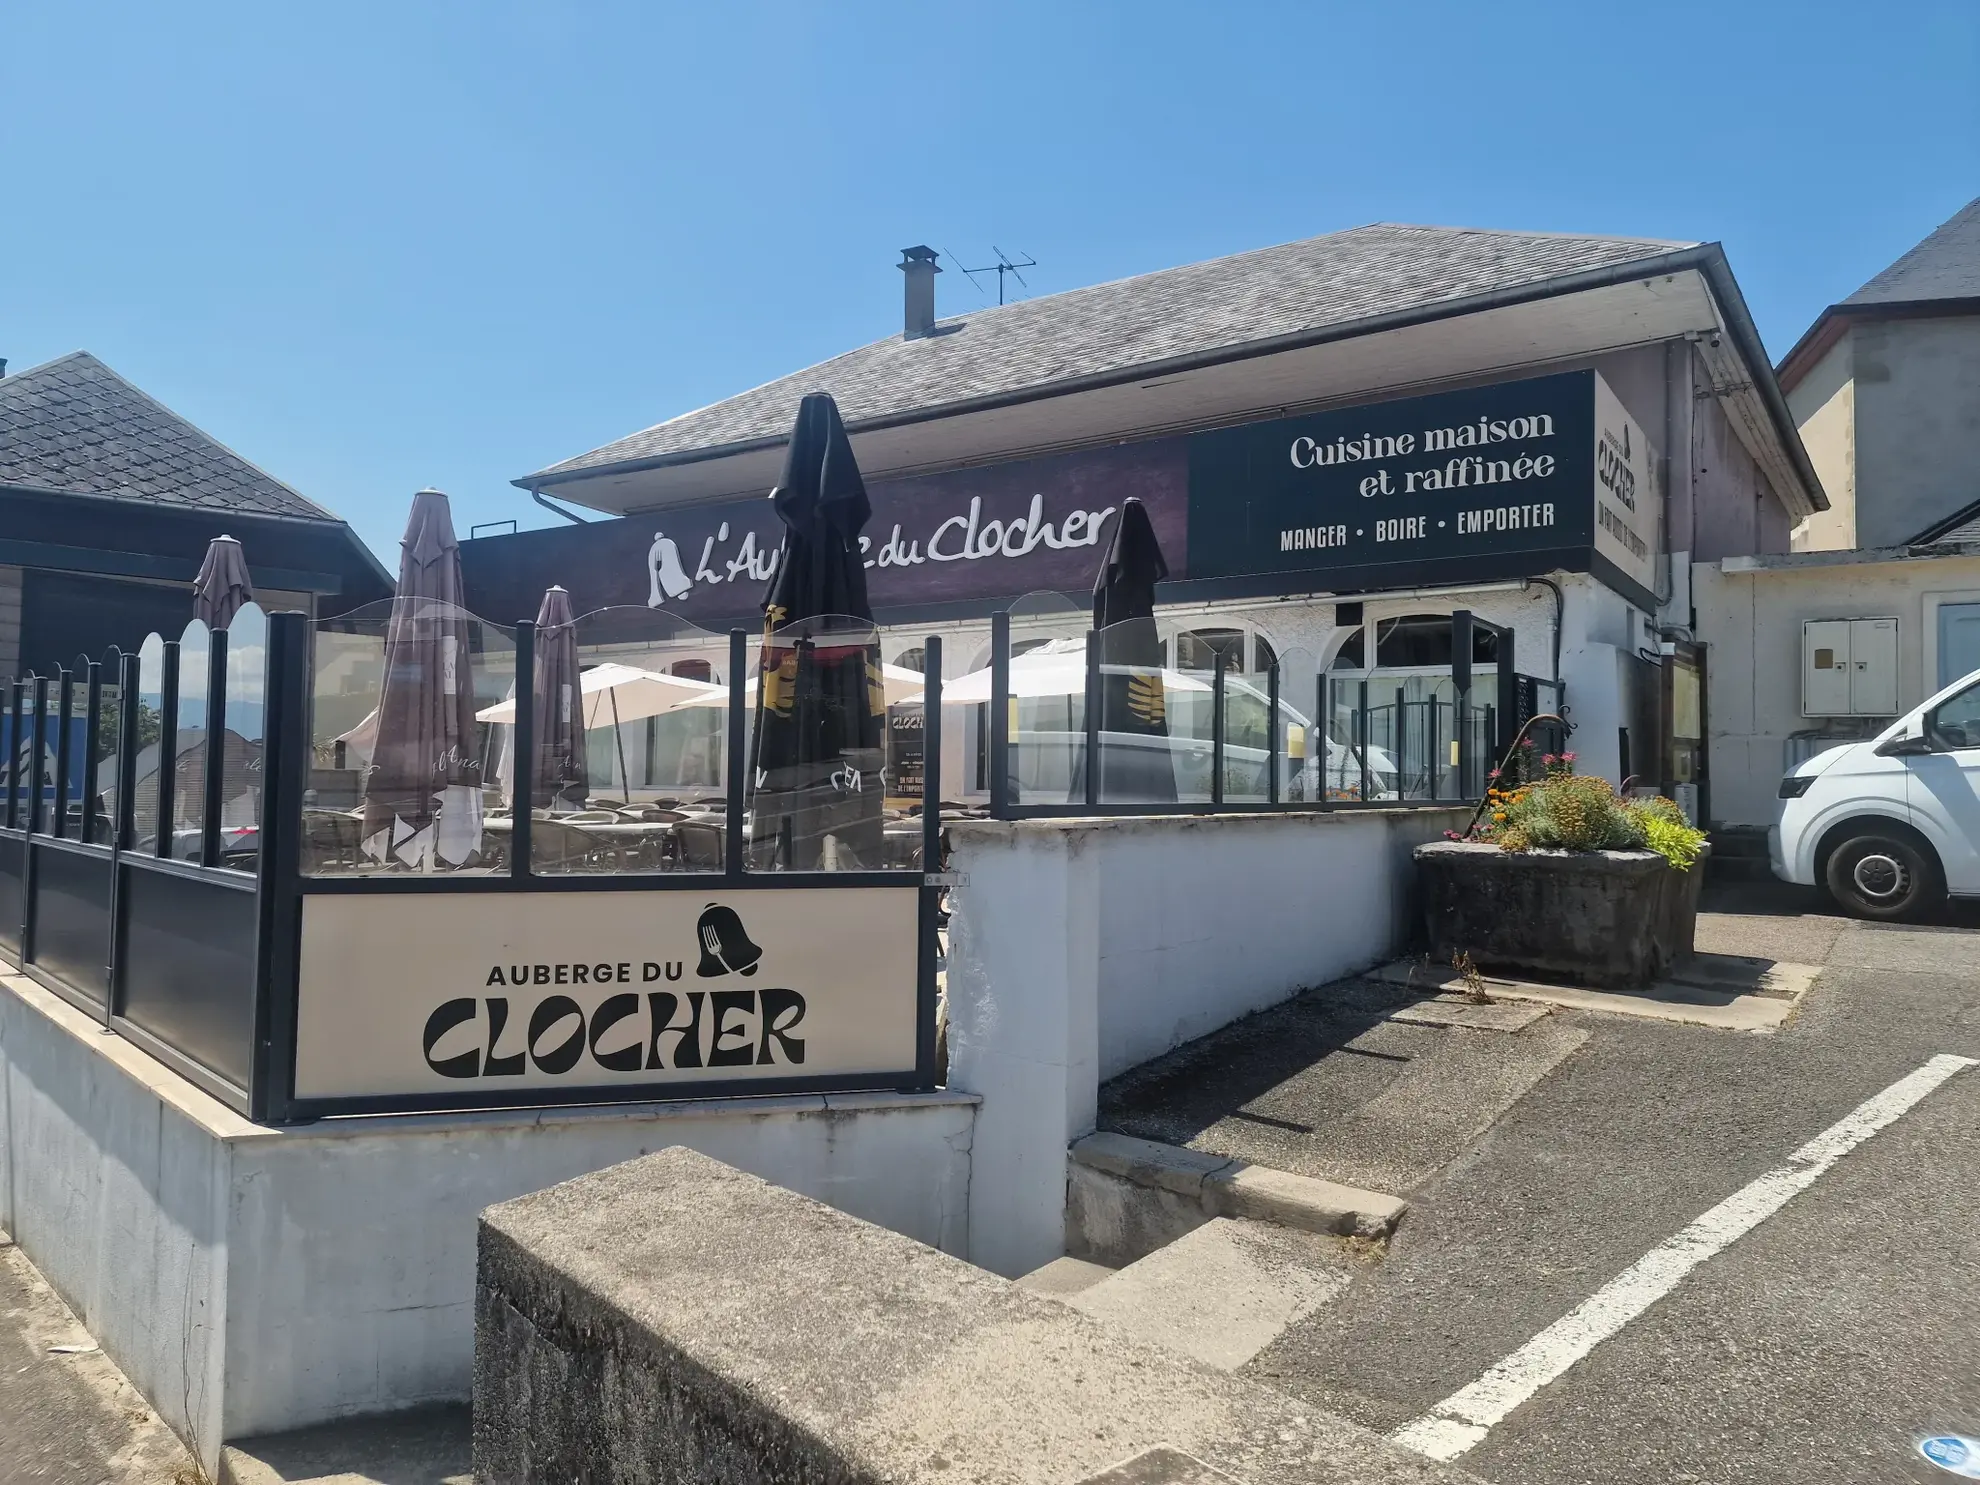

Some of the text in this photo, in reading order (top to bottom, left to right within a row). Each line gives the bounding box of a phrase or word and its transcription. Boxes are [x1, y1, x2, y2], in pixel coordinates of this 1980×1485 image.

[1290, 414, 1555, 470] Cuisine maison
[1359, 452, 1555, 498] et raffinée
[878, 524, 925, 568] du
[927, 493, 1117, 561] Clocher
[1280, 503, 1555, 552] MANGER BOIRE EMPORTER
[485, 961, 683, 987] AUBERGE DU
[422, 988, 807, 1079] CLOCHER
